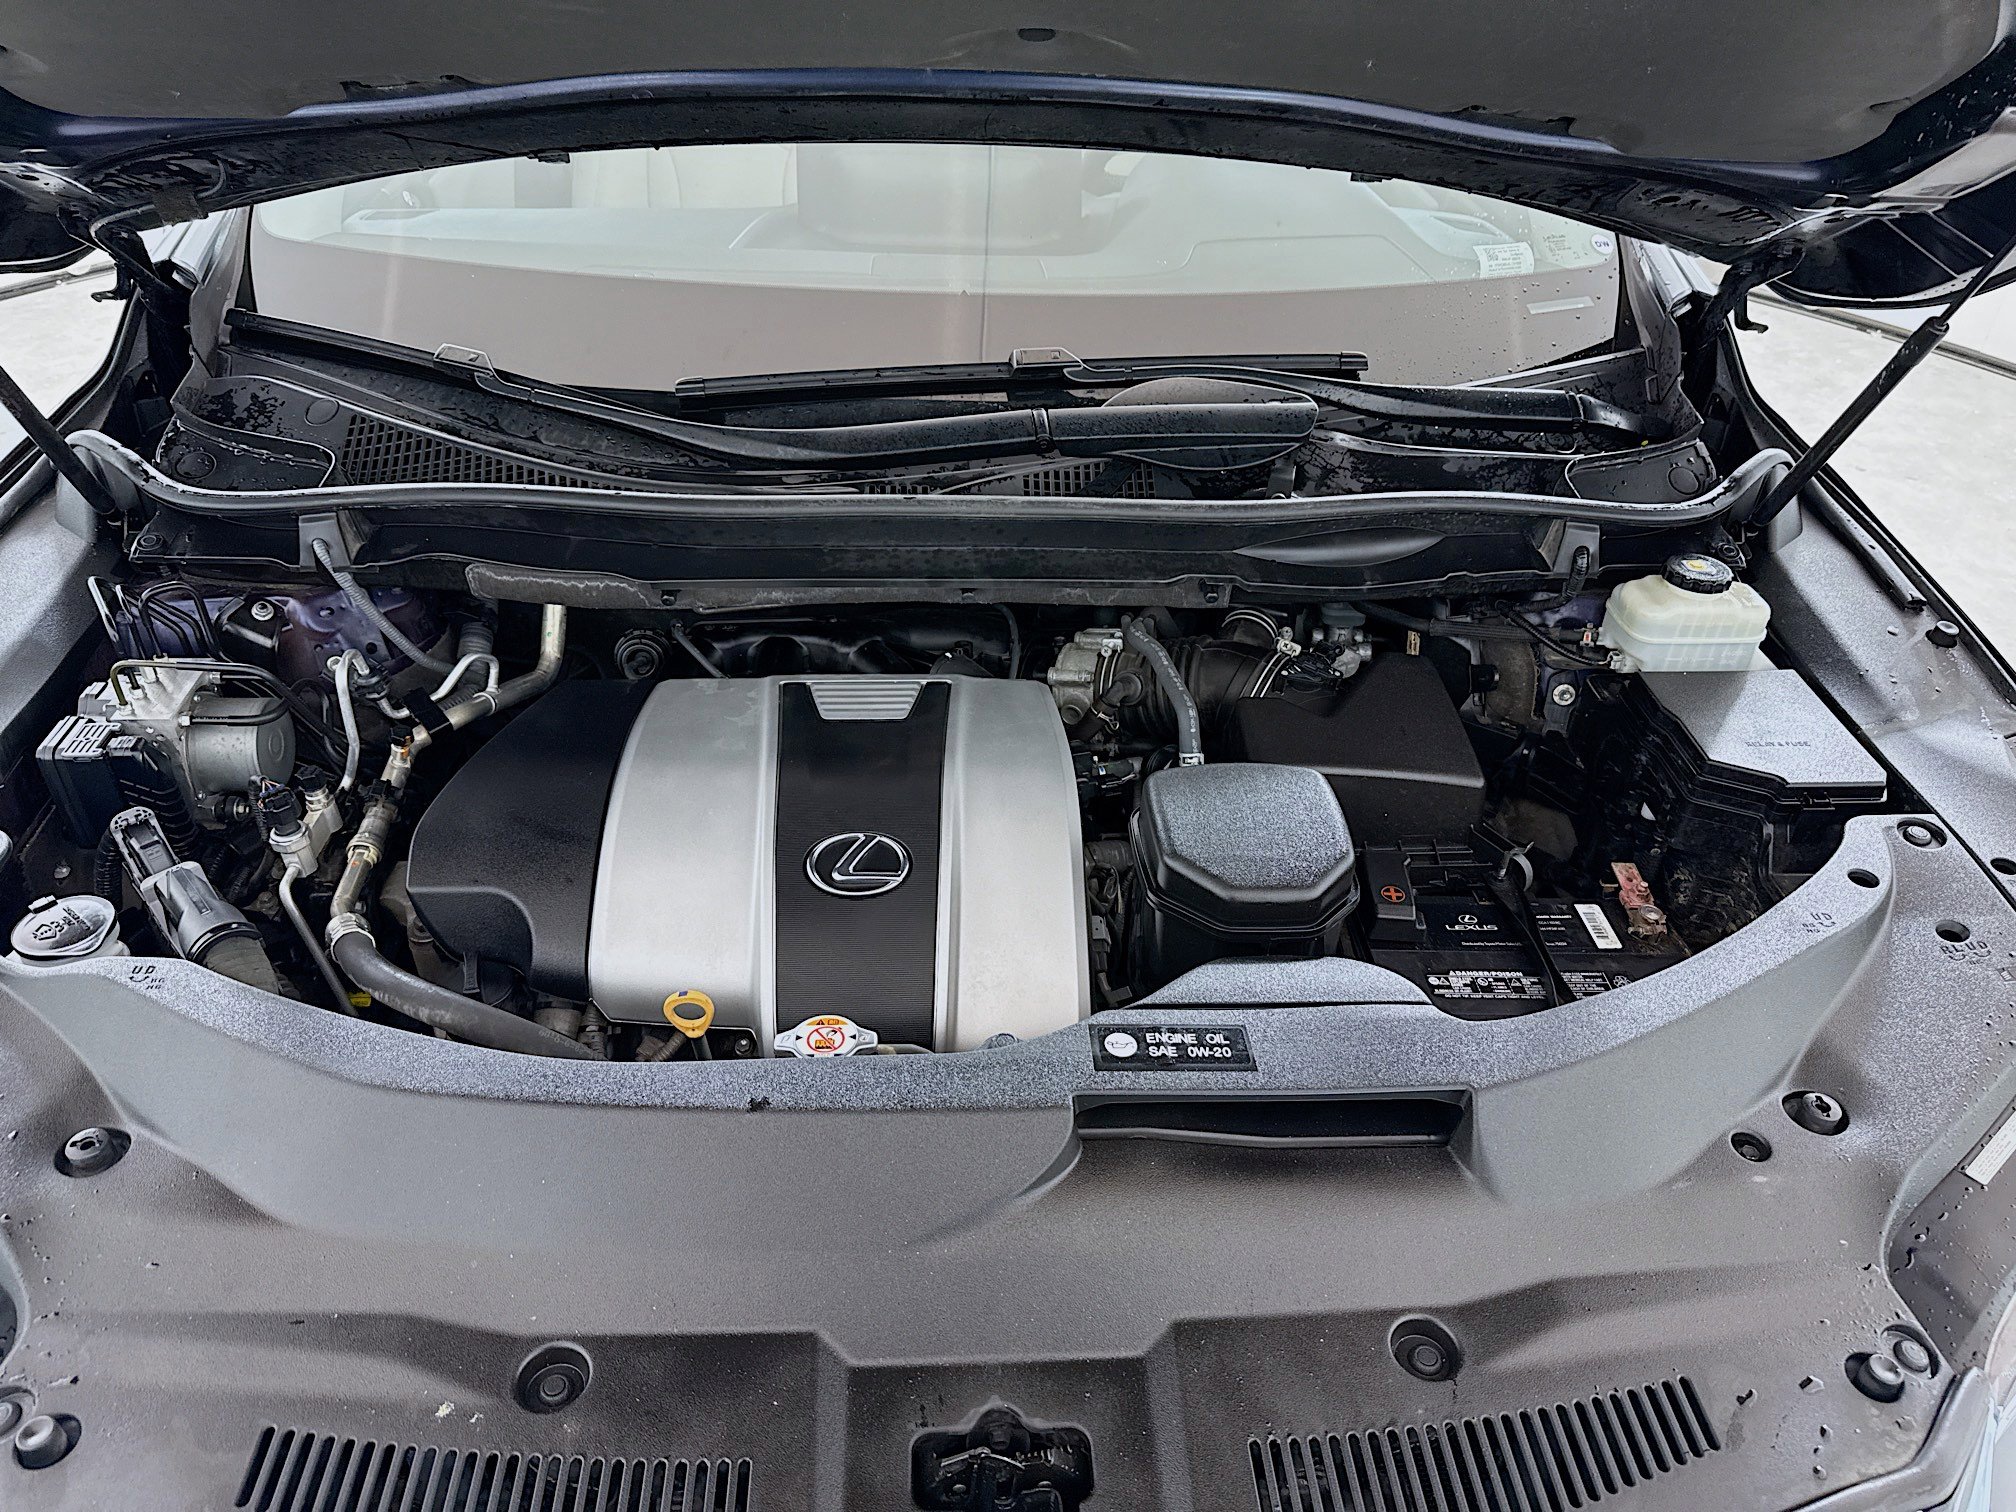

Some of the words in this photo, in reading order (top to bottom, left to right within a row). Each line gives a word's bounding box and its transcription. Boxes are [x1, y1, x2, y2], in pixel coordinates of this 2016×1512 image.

[1145, 1032, 1198, 1044] ENGINE
[1205, 1033, 1230, 1045] OIL
[1148, 1046, 1178, 1057] SAE
[1187, 1046, 1232, 1058] 0W-20
